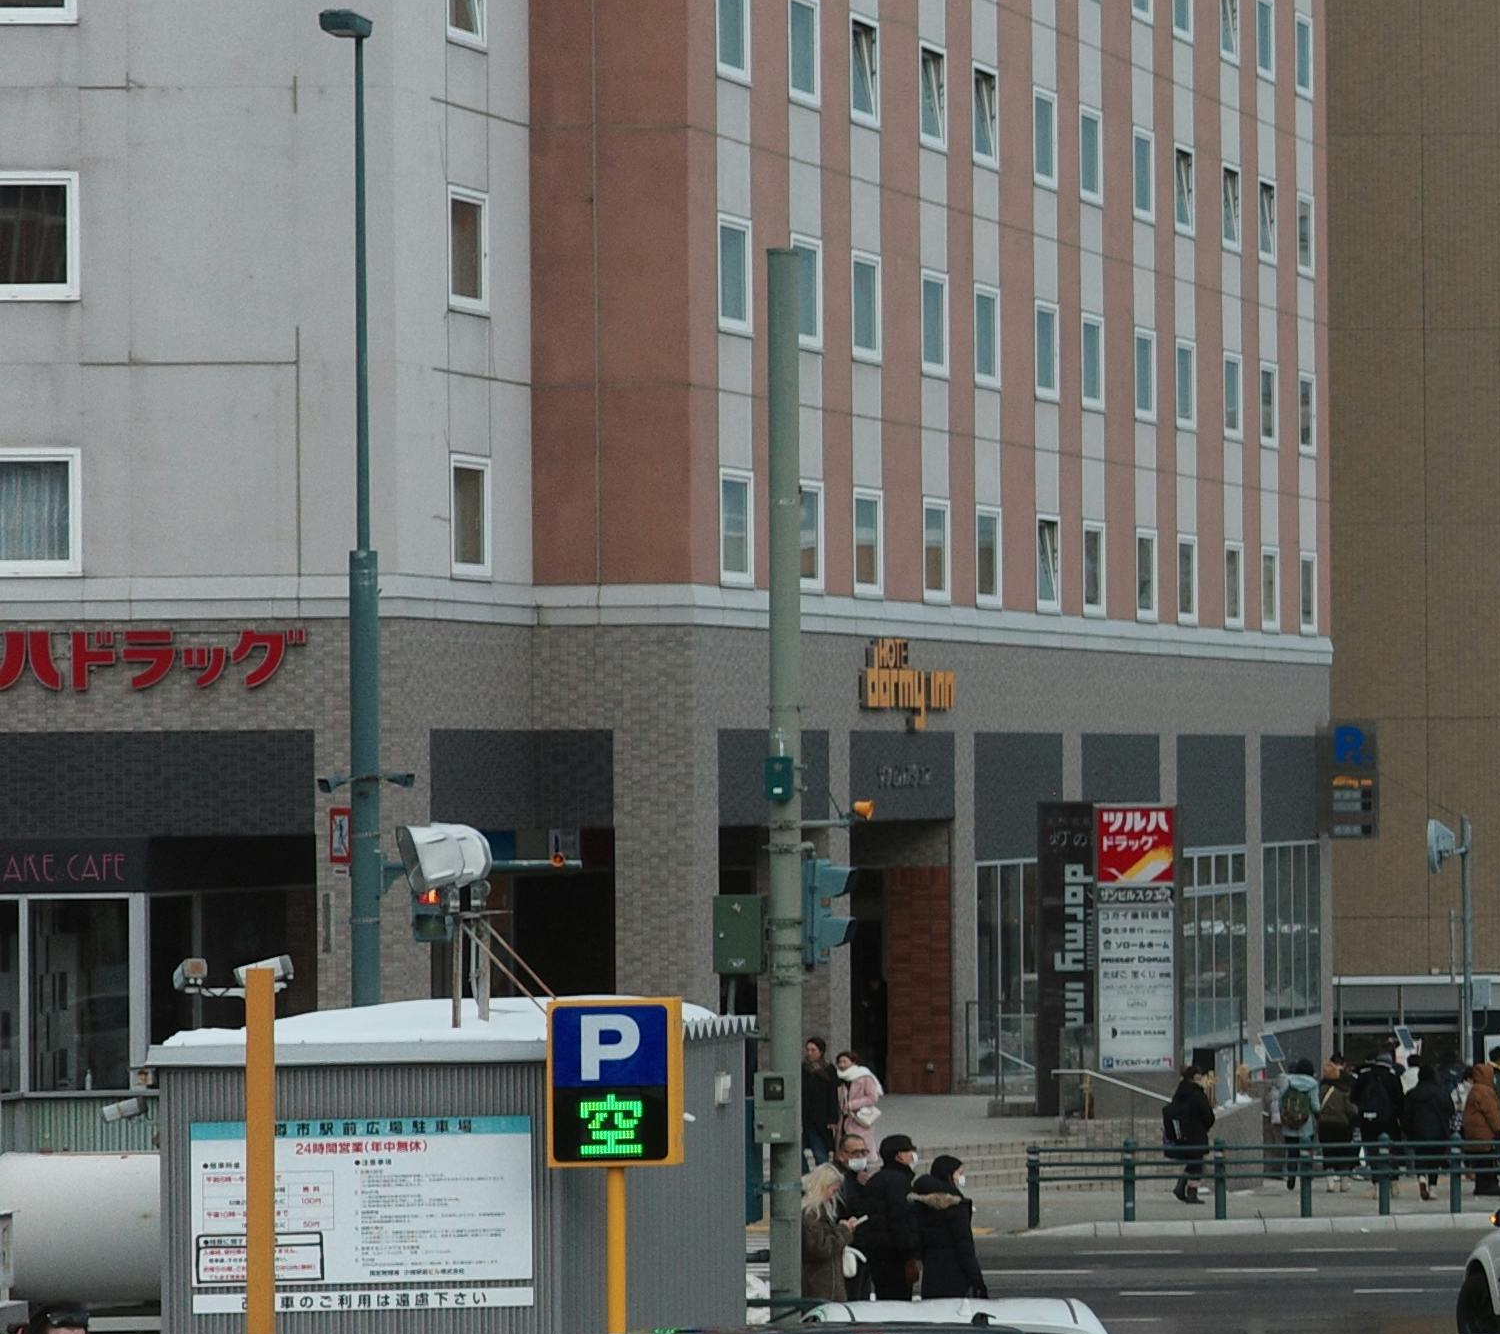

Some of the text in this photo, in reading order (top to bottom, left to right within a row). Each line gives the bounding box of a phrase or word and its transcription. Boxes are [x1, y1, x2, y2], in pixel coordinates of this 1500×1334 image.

[0, 629, 305, 691] ハドラッグ
[867, 643, 957, 730] dormy inn
[1102, 810, 1169, 833] ツルハ
[1102, 835, 1159, 852] ドラッグ
[67, 853, 125, 881] CAFE
[1054, 864, 1093, 1028] dormy inn
[580, 1015, 640, 1080] P
[275, 1120, 472, 1137] 樽市駅前広場駐車場
[579, 1094, 643, 1158] 空
[241, 1292, 488, 1309] 車のご利用は遠慮下さい
